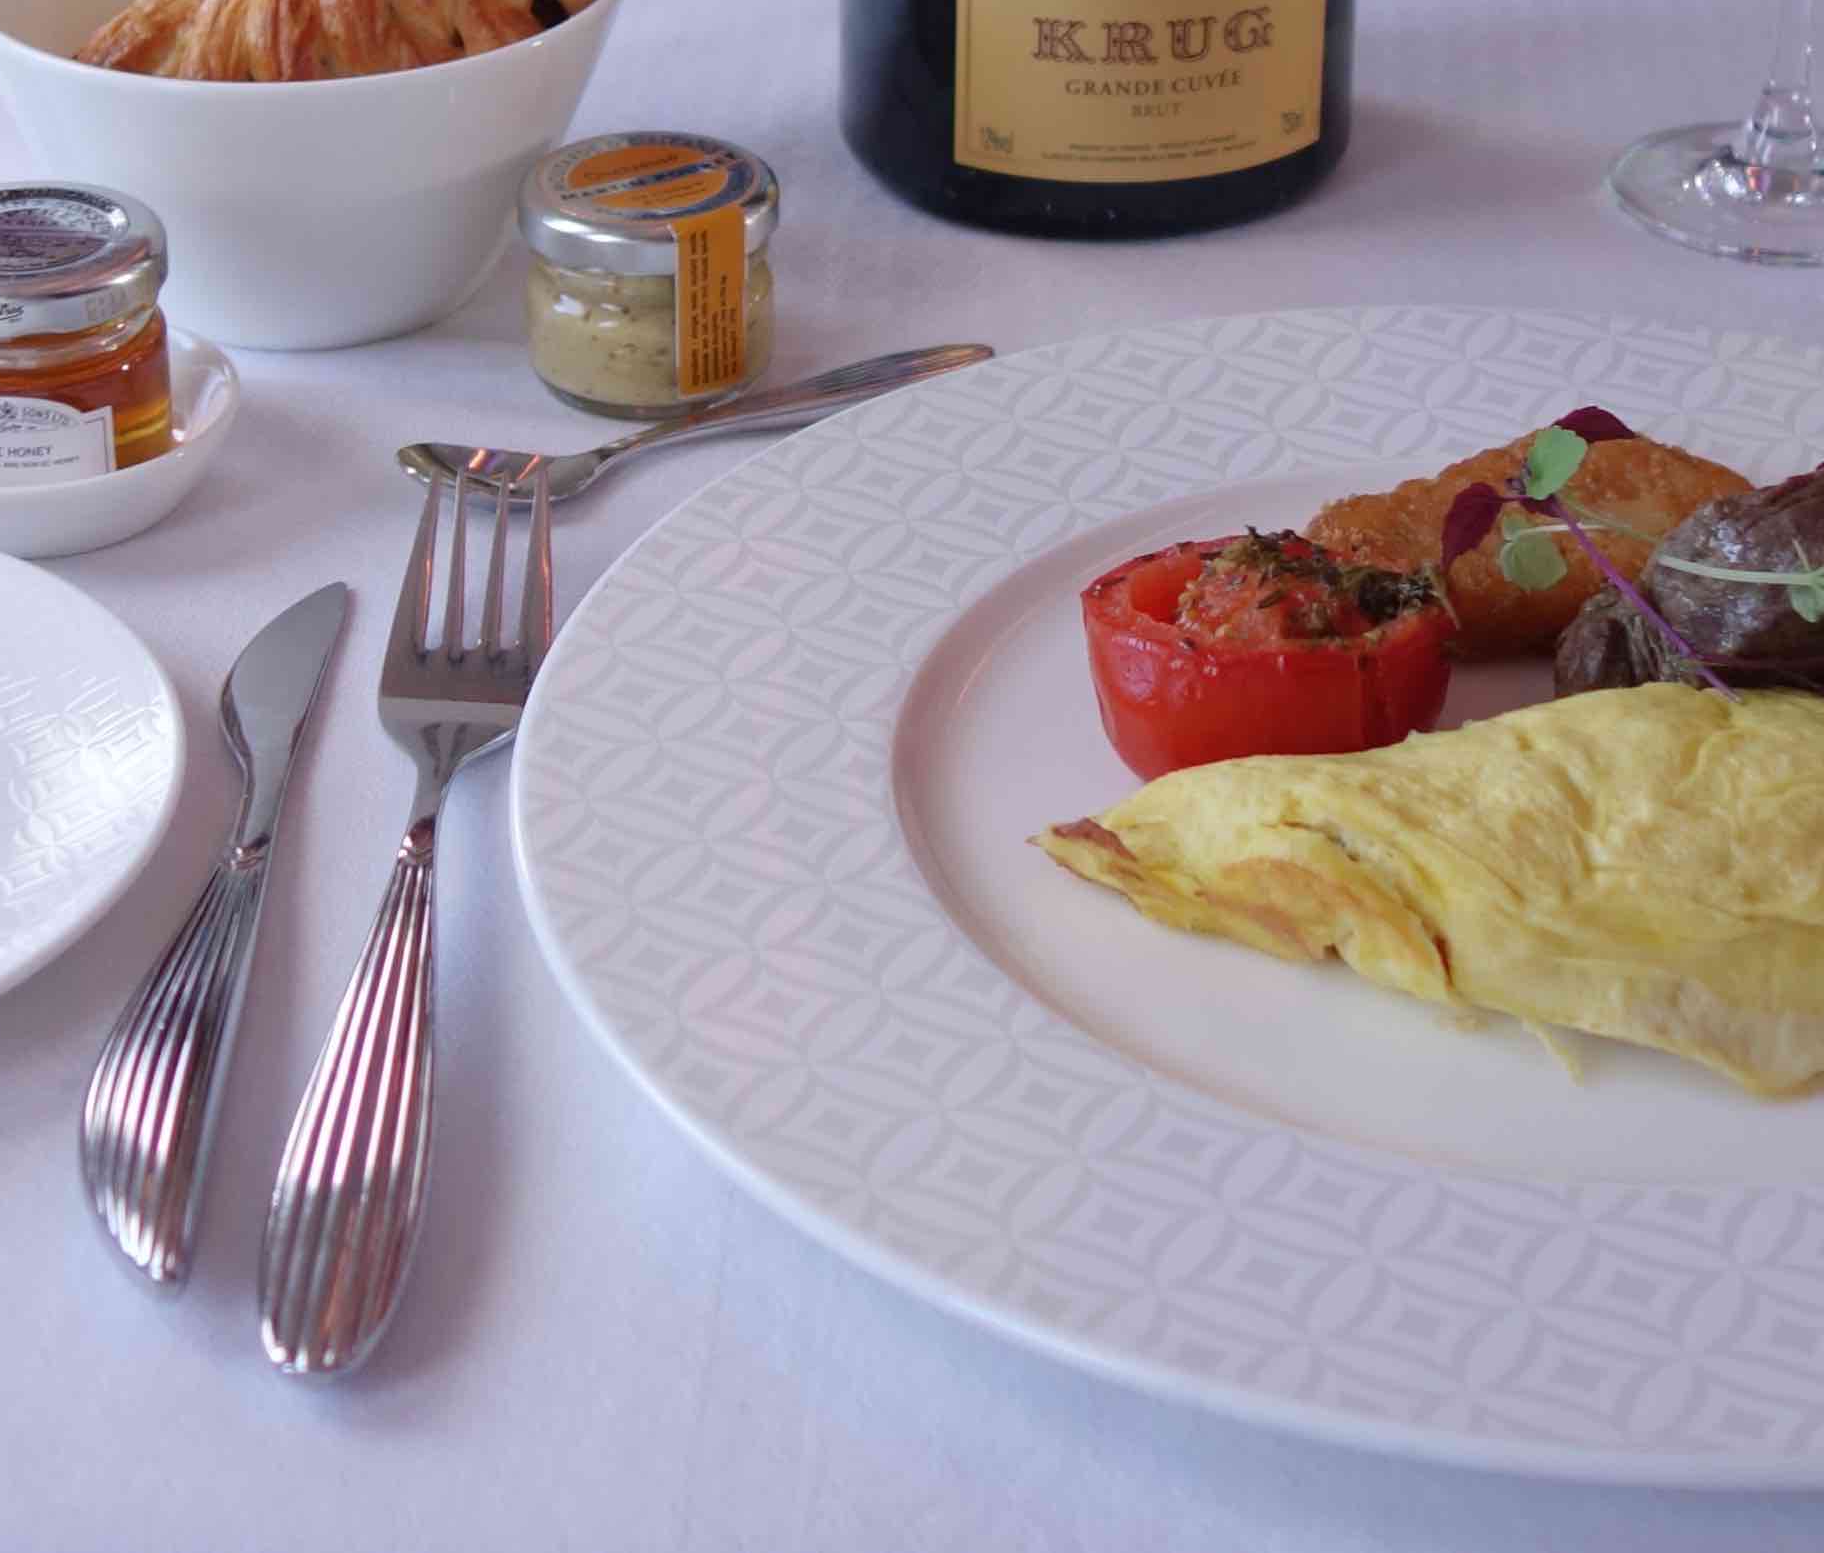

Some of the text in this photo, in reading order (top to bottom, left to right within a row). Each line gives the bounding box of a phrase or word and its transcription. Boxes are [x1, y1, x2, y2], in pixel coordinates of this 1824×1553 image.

[1031, 5, 1275, 66] KRUG
[1065, 77, 1163, 97] GRANDE
[1130, 102, 1184, 118] BRUT
[7, 444, 55, 459] HONEY
